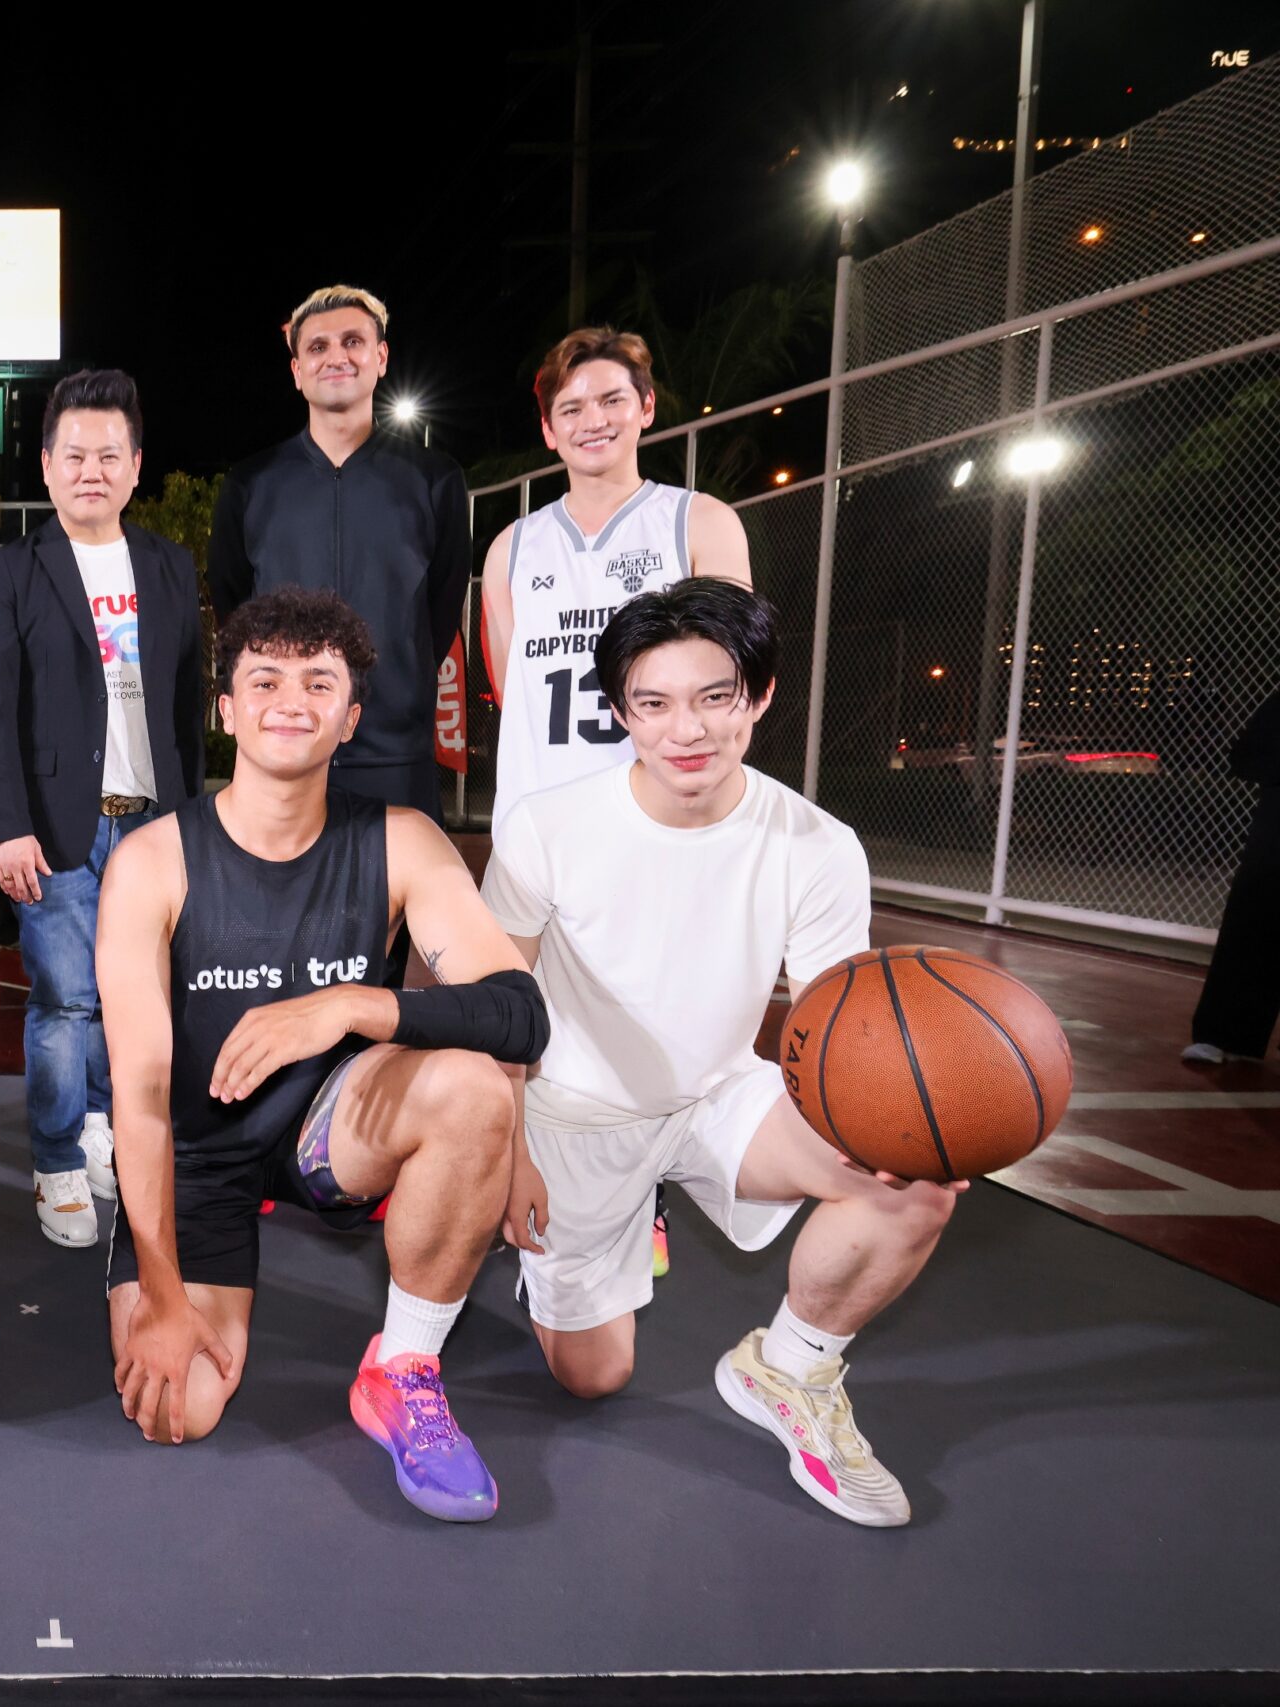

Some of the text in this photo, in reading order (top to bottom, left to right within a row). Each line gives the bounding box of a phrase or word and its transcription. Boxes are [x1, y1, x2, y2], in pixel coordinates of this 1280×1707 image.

[609, 556, 658, 572] BASKET
[89, 593, 139, 617] rue
[436, 655, 466, 752] true
[545, 667, 630, 746] 13
[307, 955, 368, 986] true
